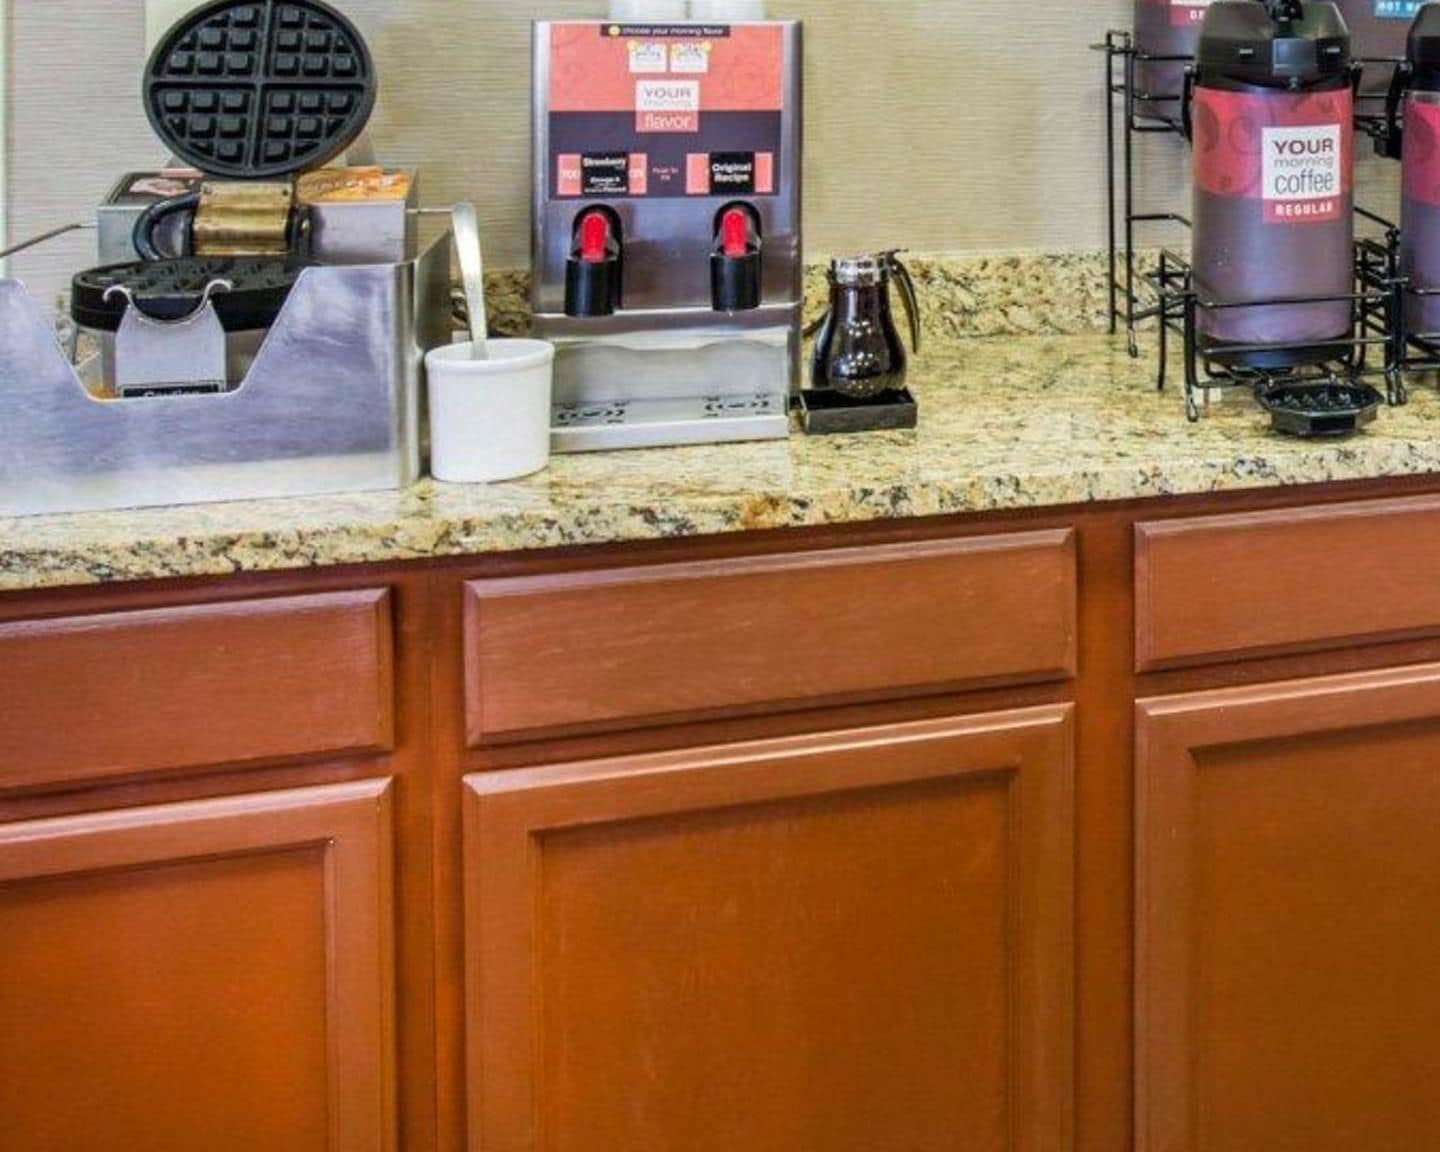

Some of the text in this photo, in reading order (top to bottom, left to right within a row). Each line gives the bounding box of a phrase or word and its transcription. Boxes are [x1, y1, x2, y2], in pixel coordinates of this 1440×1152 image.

[642, 85, 692, 98] YOUR
[644, 112, 692, 129] flavor
[1273, 138, 1334, 154] YOUR
[711, 161, 752, 173] Original
[1274, 156, 1334, 169] morning
[1275, 168, 1334, 194] coffee
[1275, 201, 1333, 216] REGULAR
